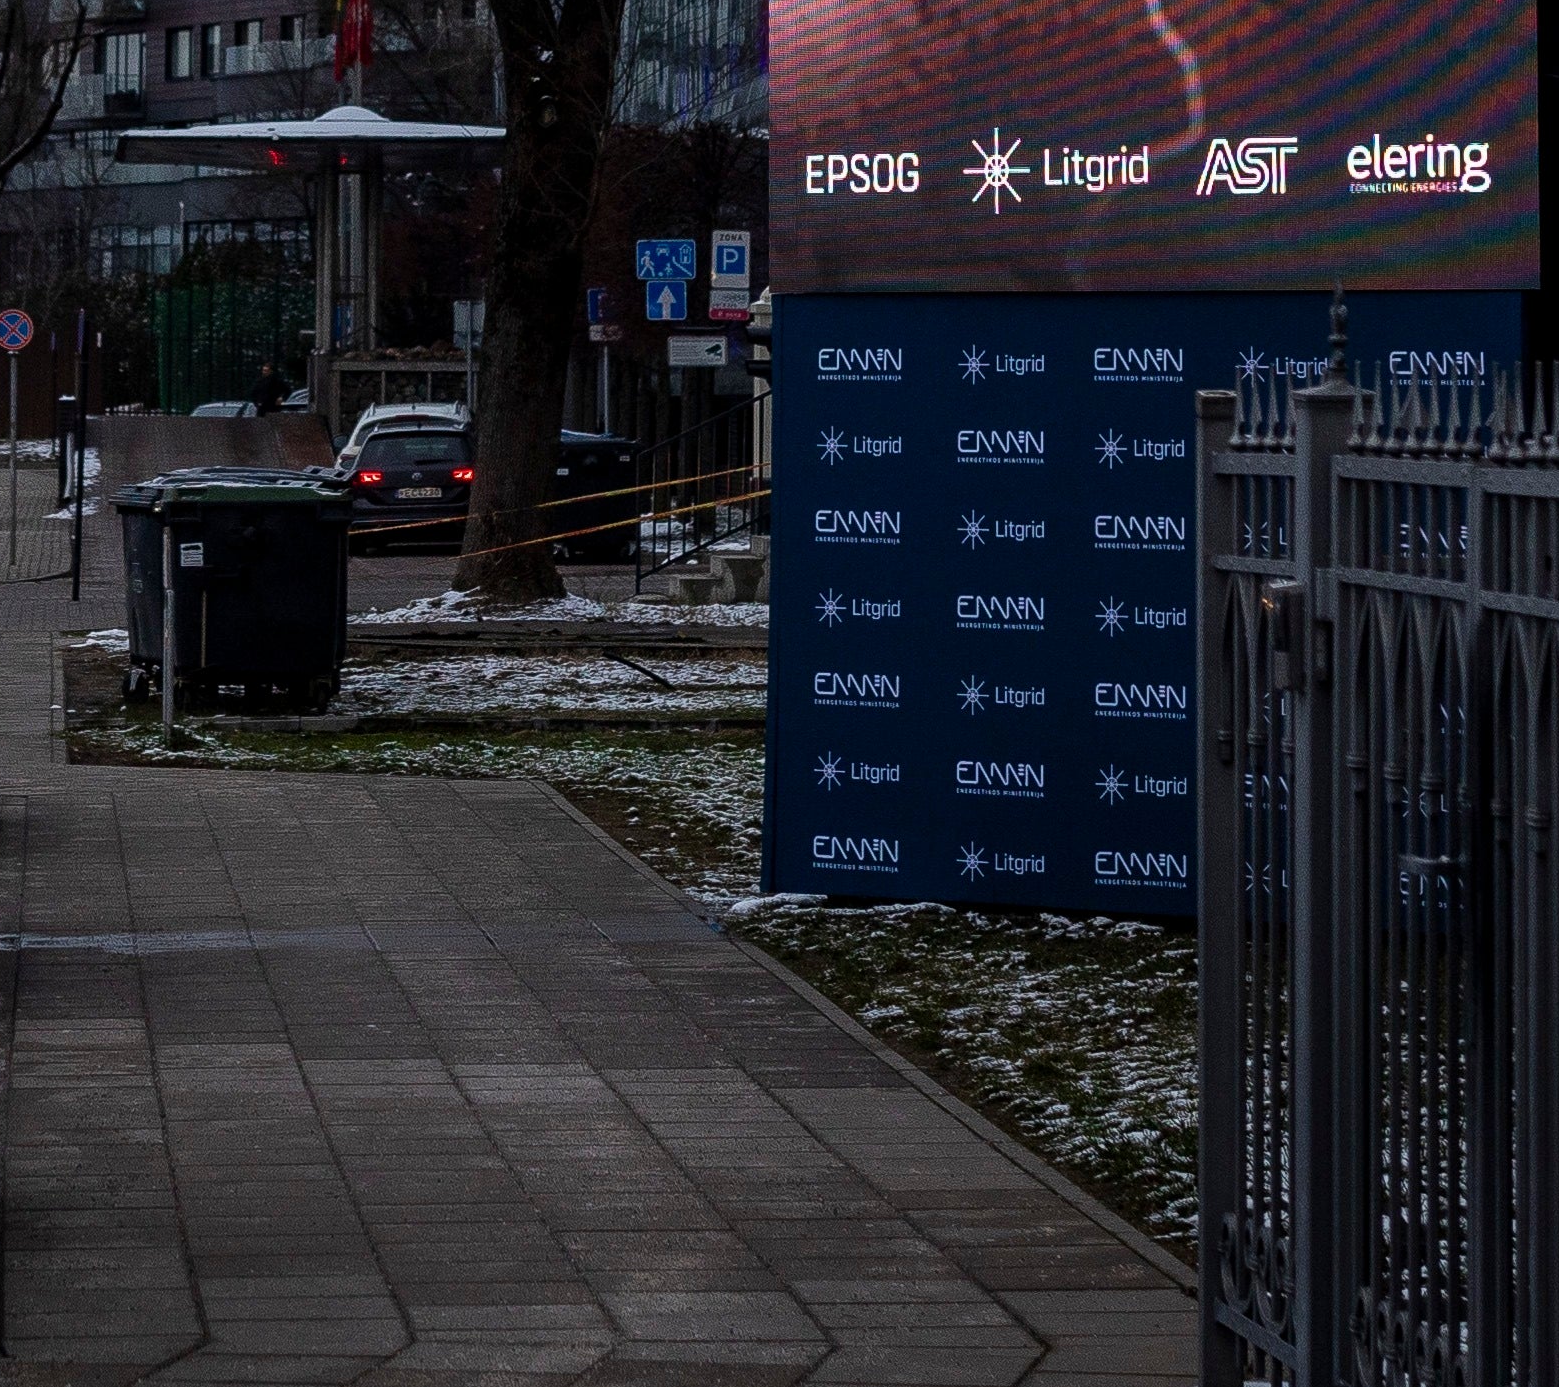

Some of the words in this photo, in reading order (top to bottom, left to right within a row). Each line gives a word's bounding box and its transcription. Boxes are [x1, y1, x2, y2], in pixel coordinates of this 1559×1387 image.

[806, 153, 919, 193] EPSOG
[1044, 146, 1149, 192] Litgrid
[1196, 137, 1298, 196] AST
[1347, 133, 1491, 193] elering
[1349, 183, 1408, 193] CONNECTING
[723, 248, 739, 271] P
[997, 355, 1044, 375] Litgrid
[1274, 357, 1327, 378] Litgrid
[862, 374, 902, 382] MINISTERIJA
[1141, 375, 1184, 383] MINISTERIJA
[854, 436, 901, 456] Litgrid
[1134, 439, 1184, 460] Litgrid
[957, 456, 1001, 464] ENERGETIKOS
[1003, 457, 1045, 465] MINISTERIJA
[996, 520, 1044, 541] Litgrid
[815, 536, 858, 544] ENERGETIKOS
[860, 537, 901, 546] MINISTERIJA
[1094, 542, 1140, 550] ENERGETIKOS
[1142, 543, 1186, 552] MINISTERIJA
[853, 599, 900, 619] Litgrid
[1136, 607, 1186, 628] Litgrid
[956, 622, 1001, 630] ENERGETIKOS
[1003, 623, 1045, 632] MINISTERIJA
[814, 698, 858, 707] ENERGETIKOS
[859, 700, 900, 709] MINISTERIJA
[996, 686, 1044, 707] Litgrid
[1094, 710, 1141, 718] ENERGETIKOS
[1143, 712, 1187, 720] MINISTERIJA
[852, 763, 899, 783] Litgrid
[956, 787, 1001, 796] ENERGETIKOS
[1002, 790, 1045, 799] MINISTERIJA
[1136, 775, 1186, 796] Litgrid
[812, 861, 856, 871] ENERGETIKOS
[858, 864, 898, 874] MINISTERIJA
[995, 853, 1044, 874] Litgrid
[1094, 878, 1141, 886] ENERGETIKOS
[1143, 880, 1187, 889] MINISTERIJA
